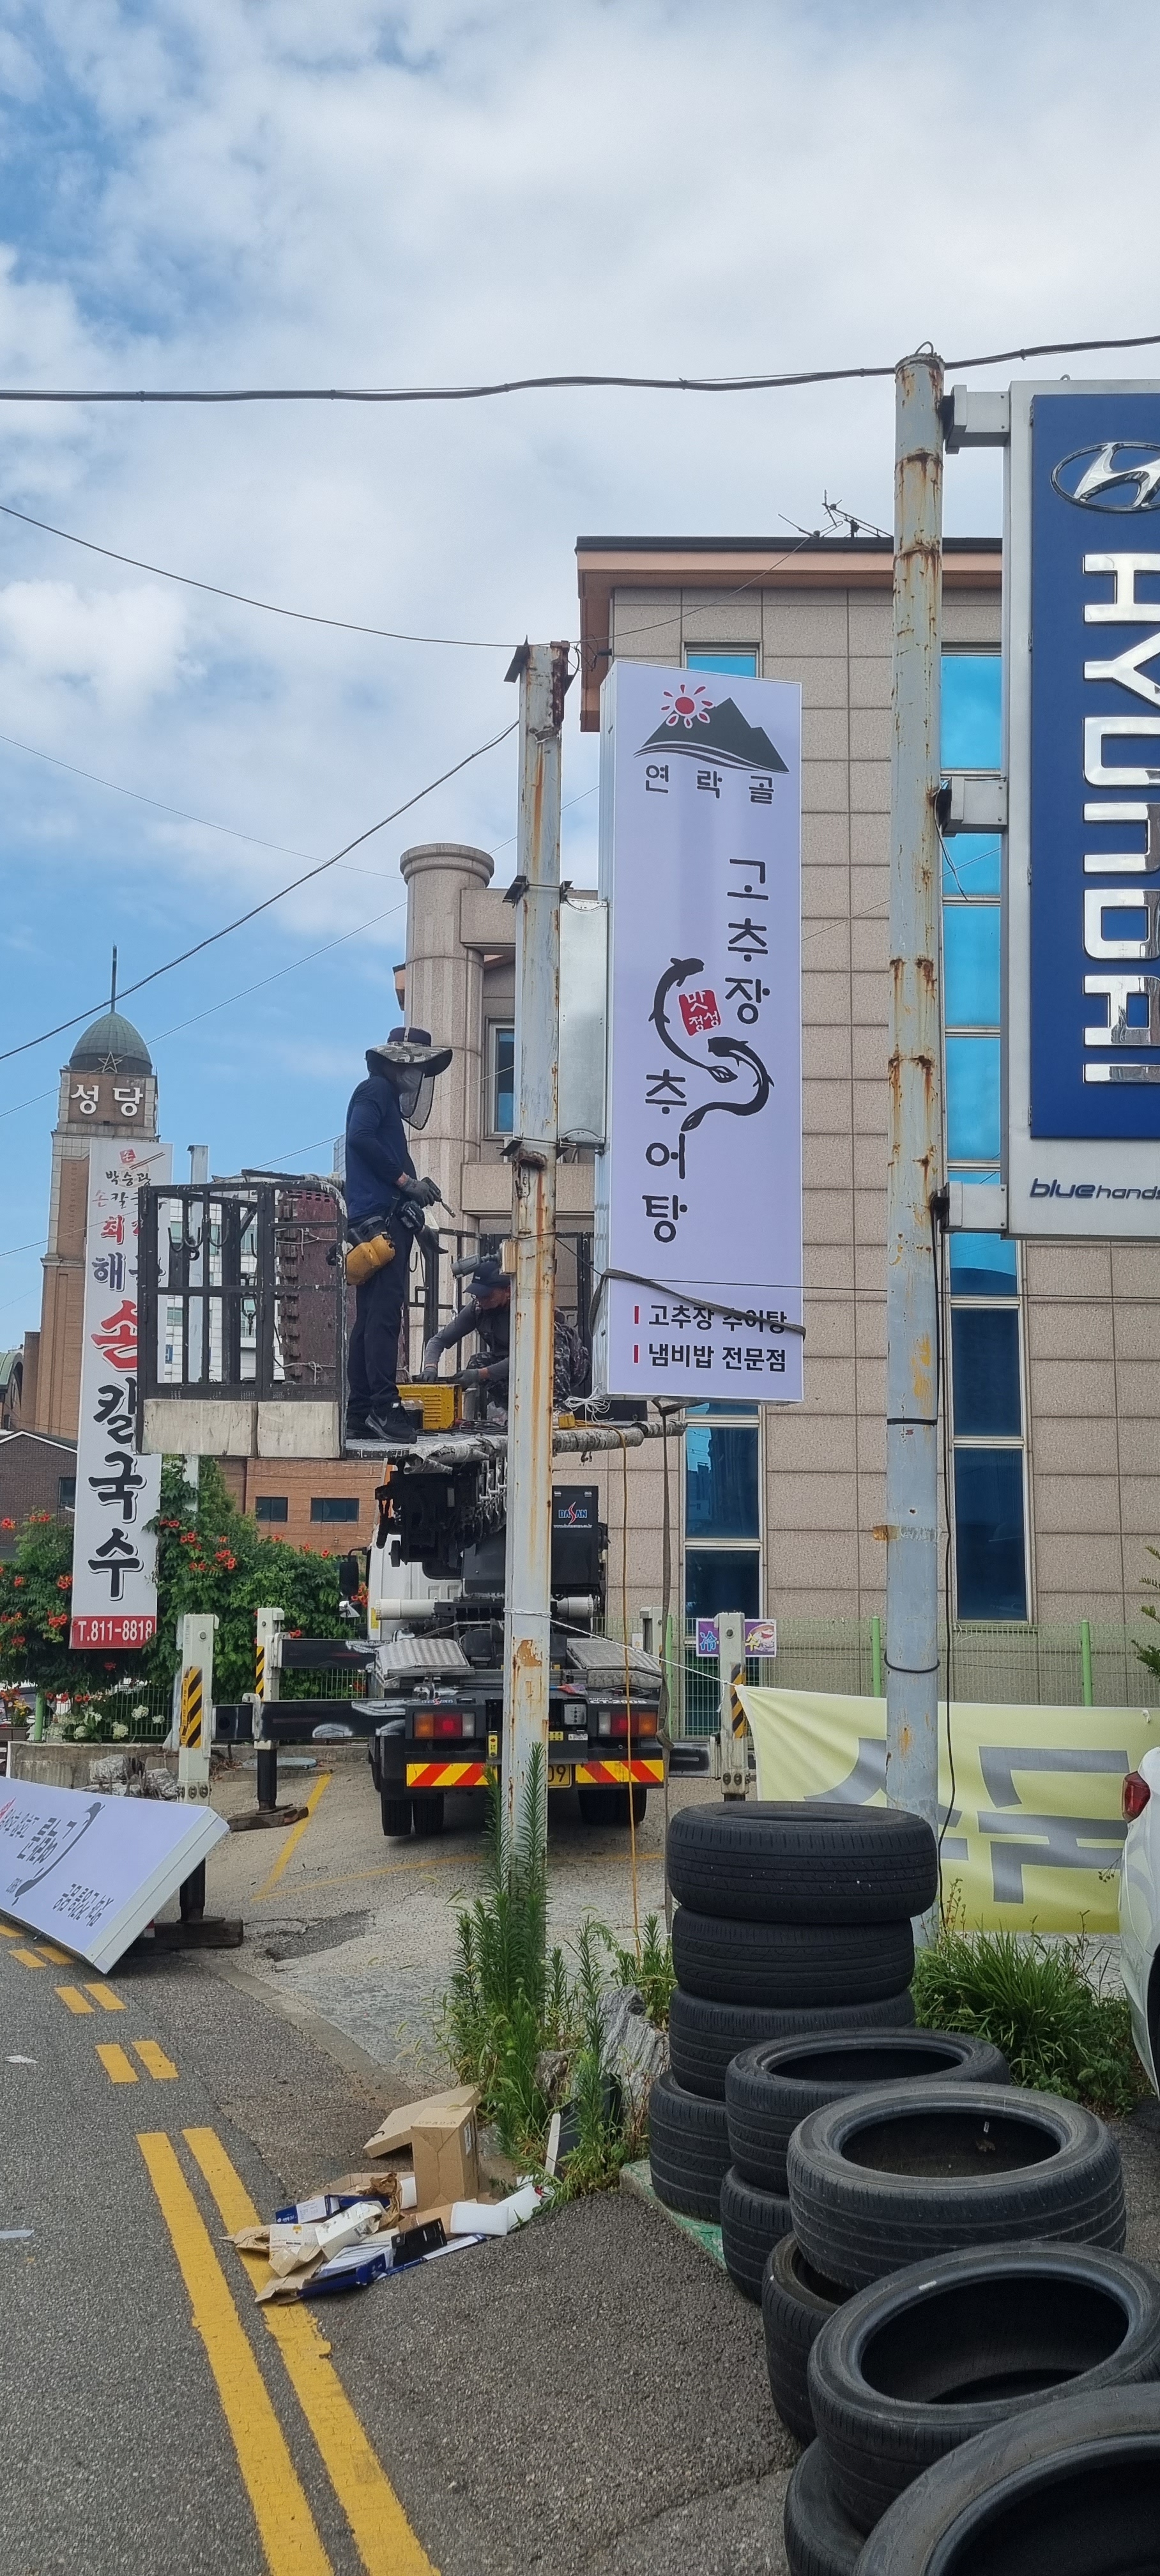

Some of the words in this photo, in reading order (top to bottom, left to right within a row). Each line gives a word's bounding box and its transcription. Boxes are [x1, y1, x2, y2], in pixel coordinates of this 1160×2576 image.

[646, 765, 774, 805] 연락골
[1082, 553, 1160, 1084] HYUNDAI
[724, 858, 769, 1025] 고추장
[685, 991, 708, 1012] 맛
[689, 1010, 719, 1032] 정성
[70, 1084, 144, 1117] 성당
[642, 1069, 688, 1243] 추어탕
[649, 1305, 714, 1331] 고추장
[649, 1344, 714, 1369] 냄비밥
[722, 1347, 786, 1372] 전문점
[78, 1620, 153, 1641] T.811-8818
